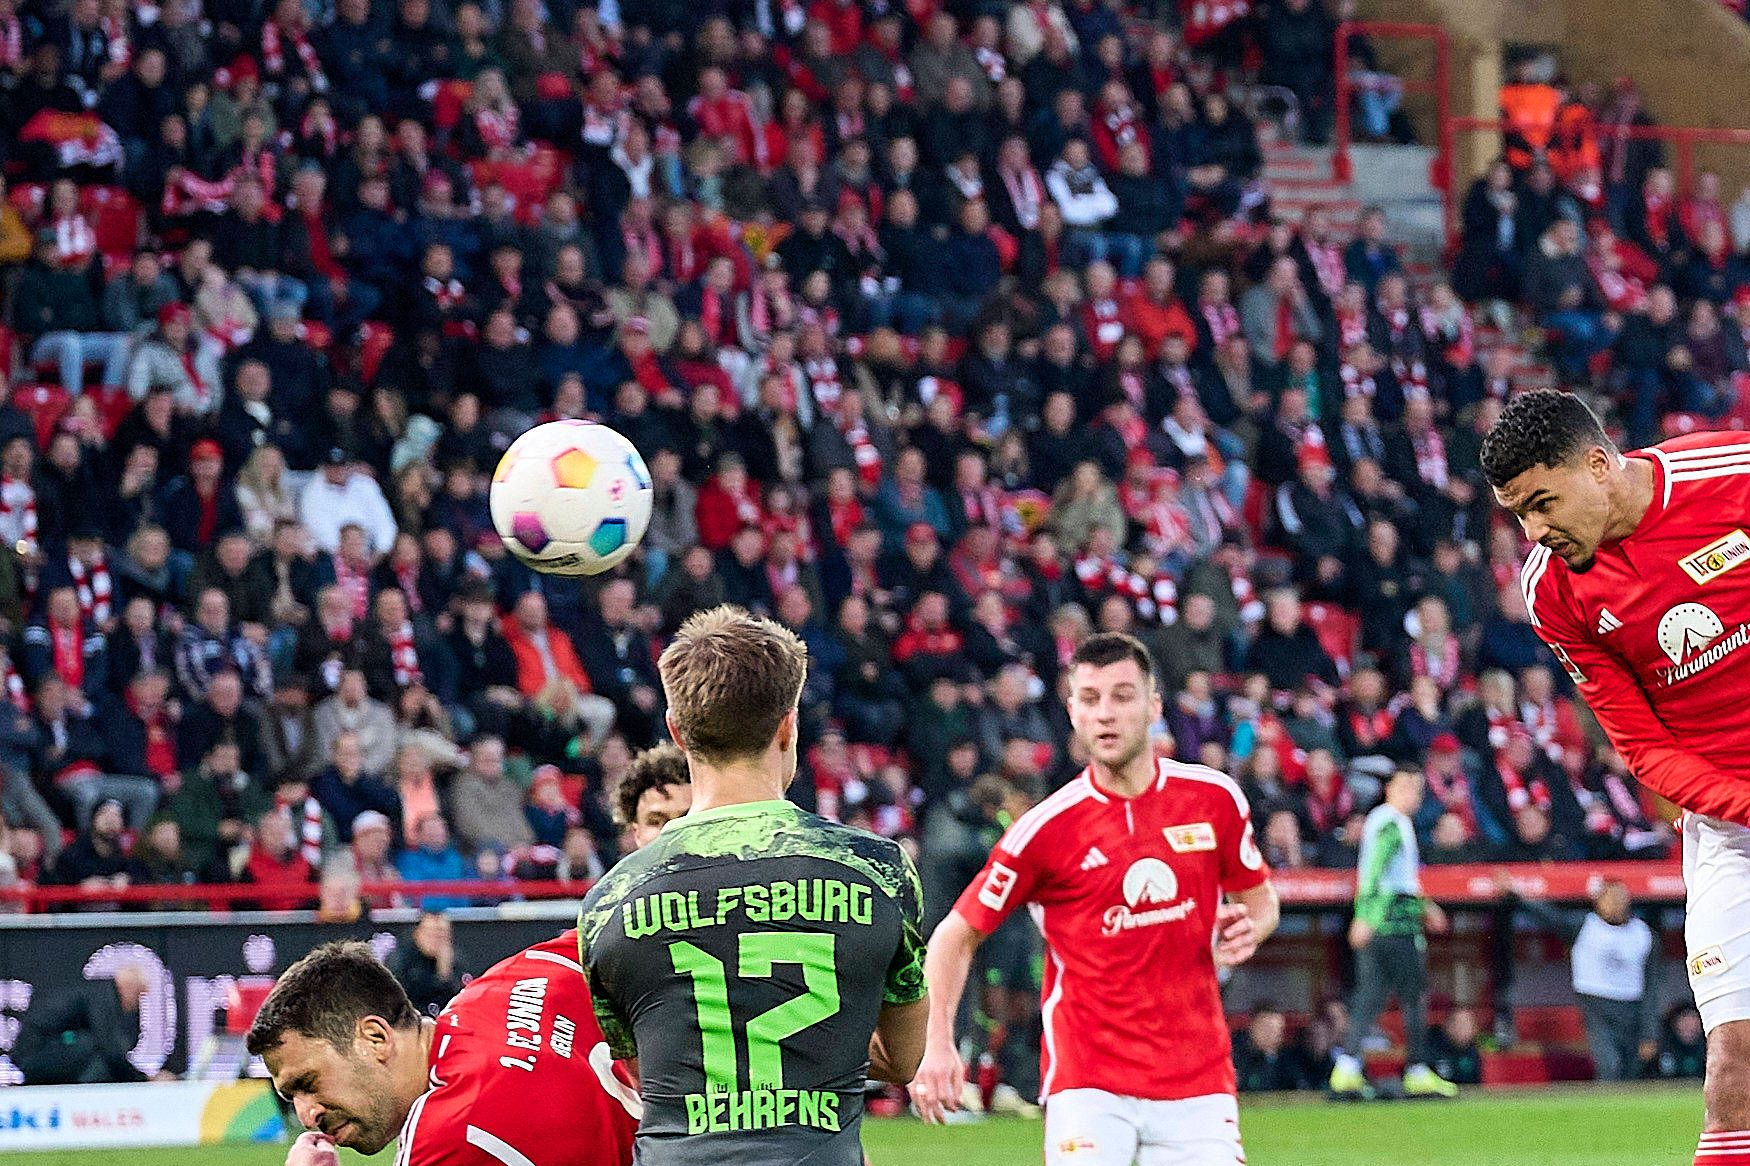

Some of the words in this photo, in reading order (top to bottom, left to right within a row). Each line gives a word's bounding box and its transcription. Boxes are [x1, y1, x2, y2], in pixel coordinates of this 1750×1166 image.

[622, 878, 874, 940] WOLFSBURG
[551, 1015, 576, 1058] BERLIN
[668, 931, 842, 1093] 17
[686, 1087, 842, 1135] BEHRENS
